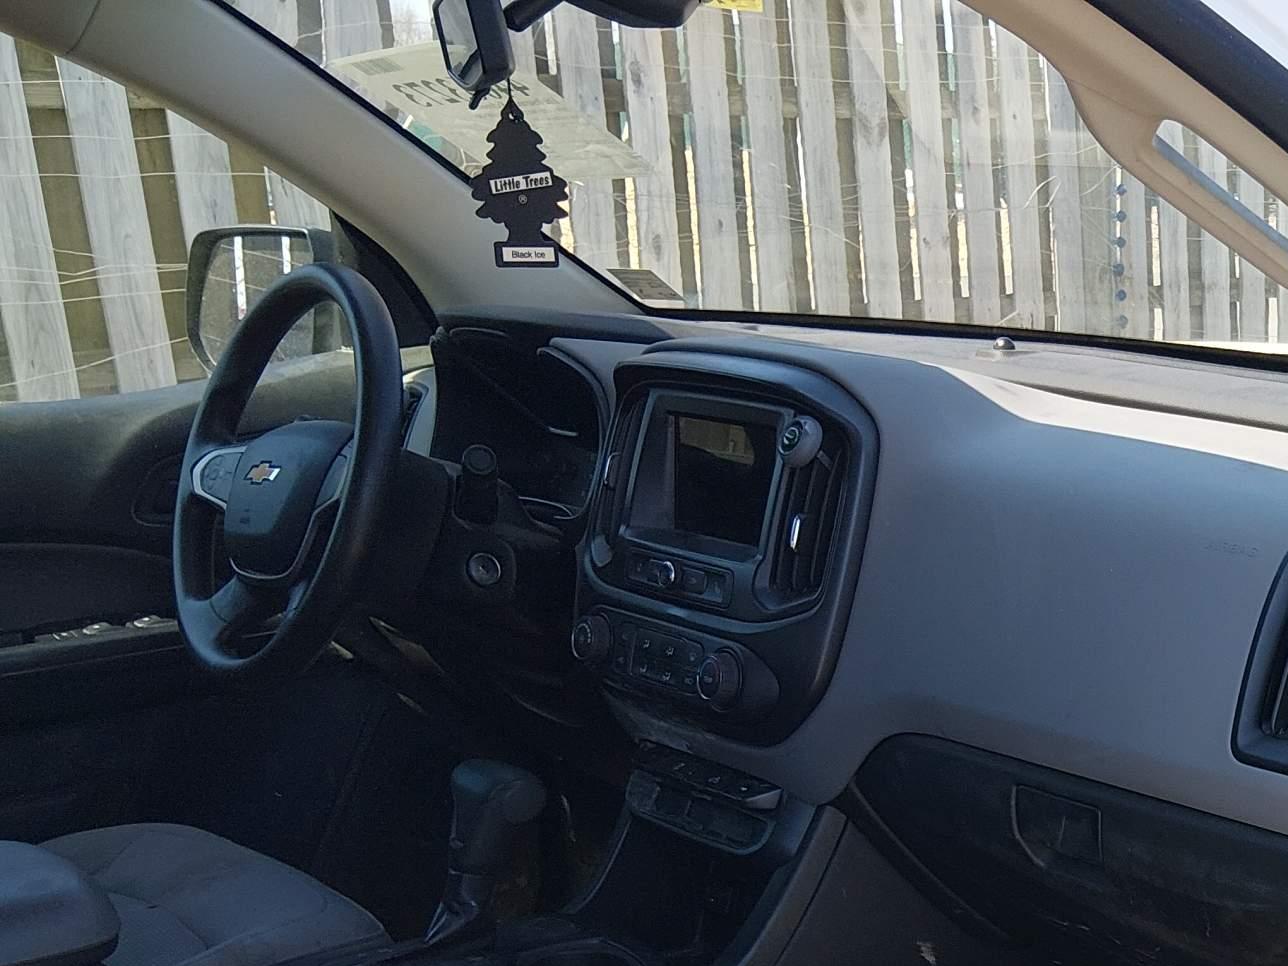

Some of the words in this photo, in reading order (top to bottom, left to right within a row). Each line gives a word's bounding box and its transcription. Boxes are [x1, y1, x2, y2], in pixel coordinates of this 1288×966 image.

[494, 178, 521, 193] Little
[522, 175, 550, 190] Trees
[511, 250, 533, 259] Black
[534, 250, 546, 259] Ice
